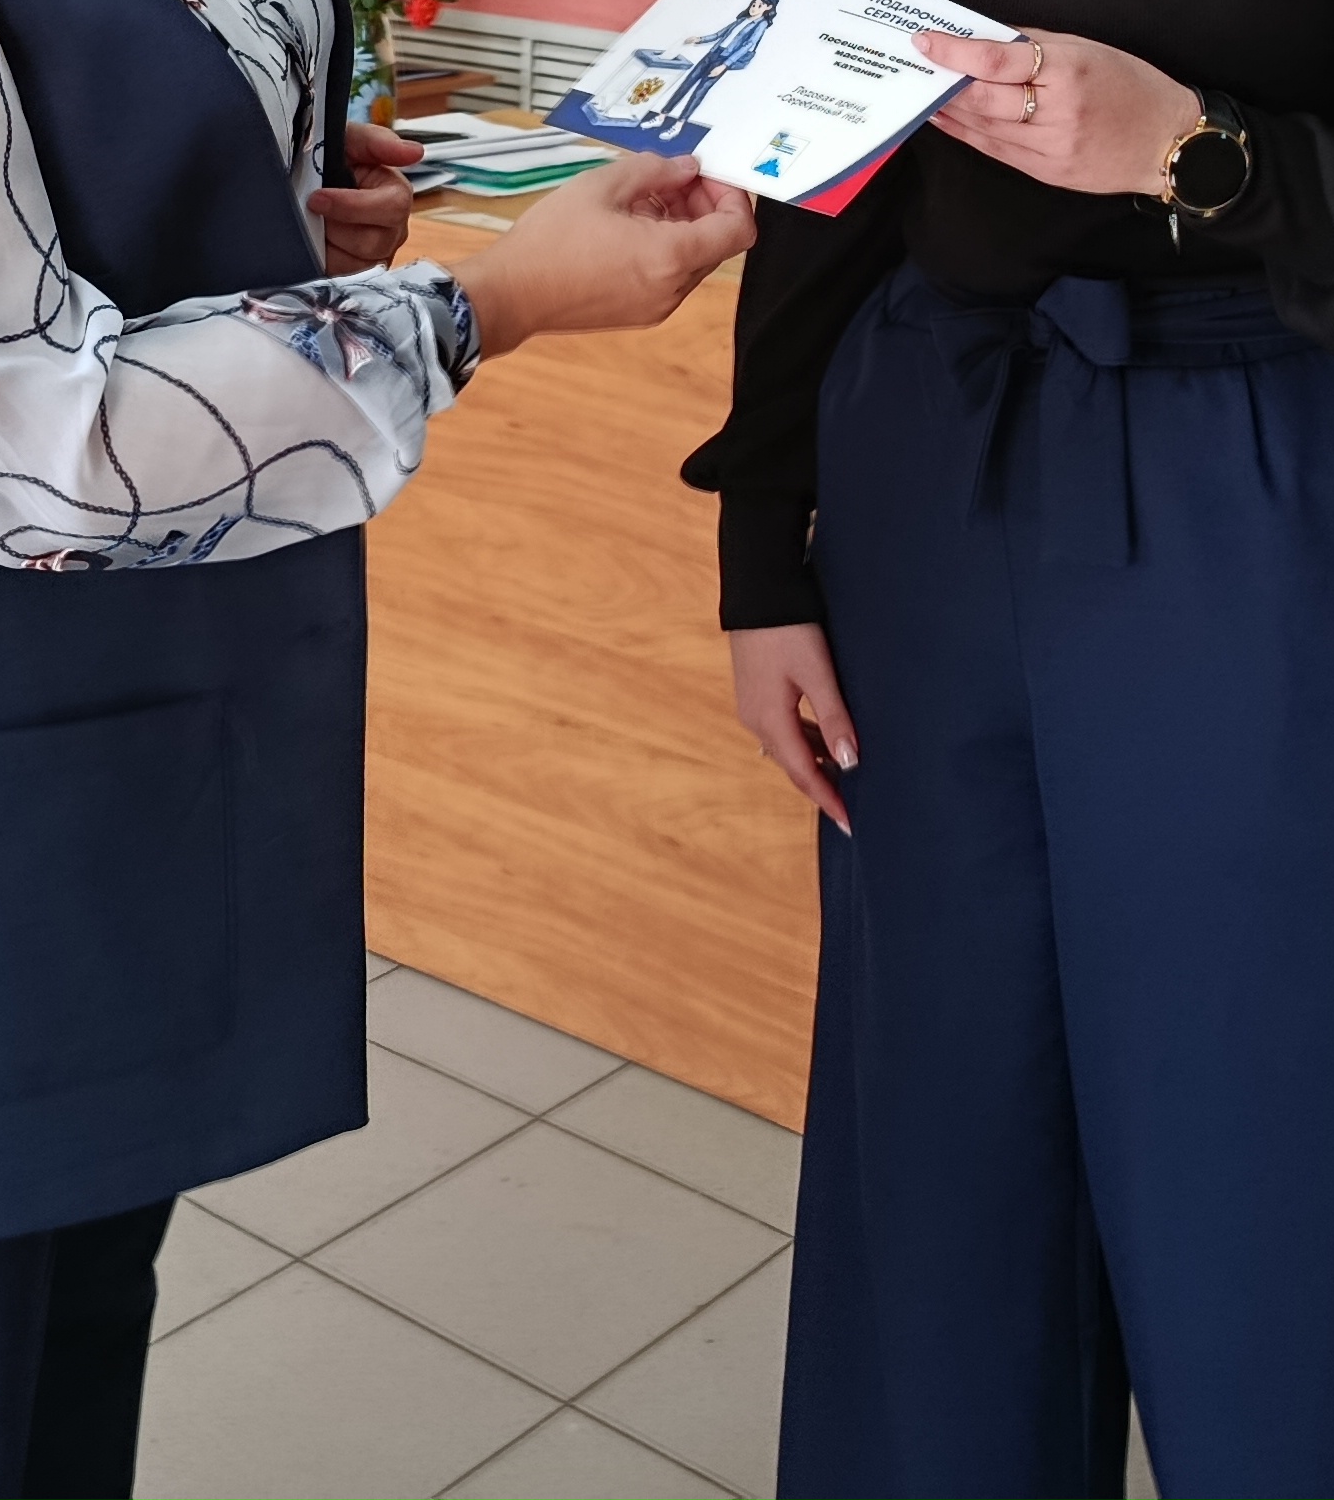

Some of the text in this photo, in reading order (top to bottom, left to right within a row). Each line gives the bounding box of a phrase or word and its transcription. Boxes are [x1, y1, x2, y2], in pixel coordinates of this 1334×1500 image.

[864, 7, 931, 33] СЕРТИФИ
[819, 33, 935, 75] Посещение сеанса
[834, 50, 900, 74] массового
[833, 61, 883, 79] катания
